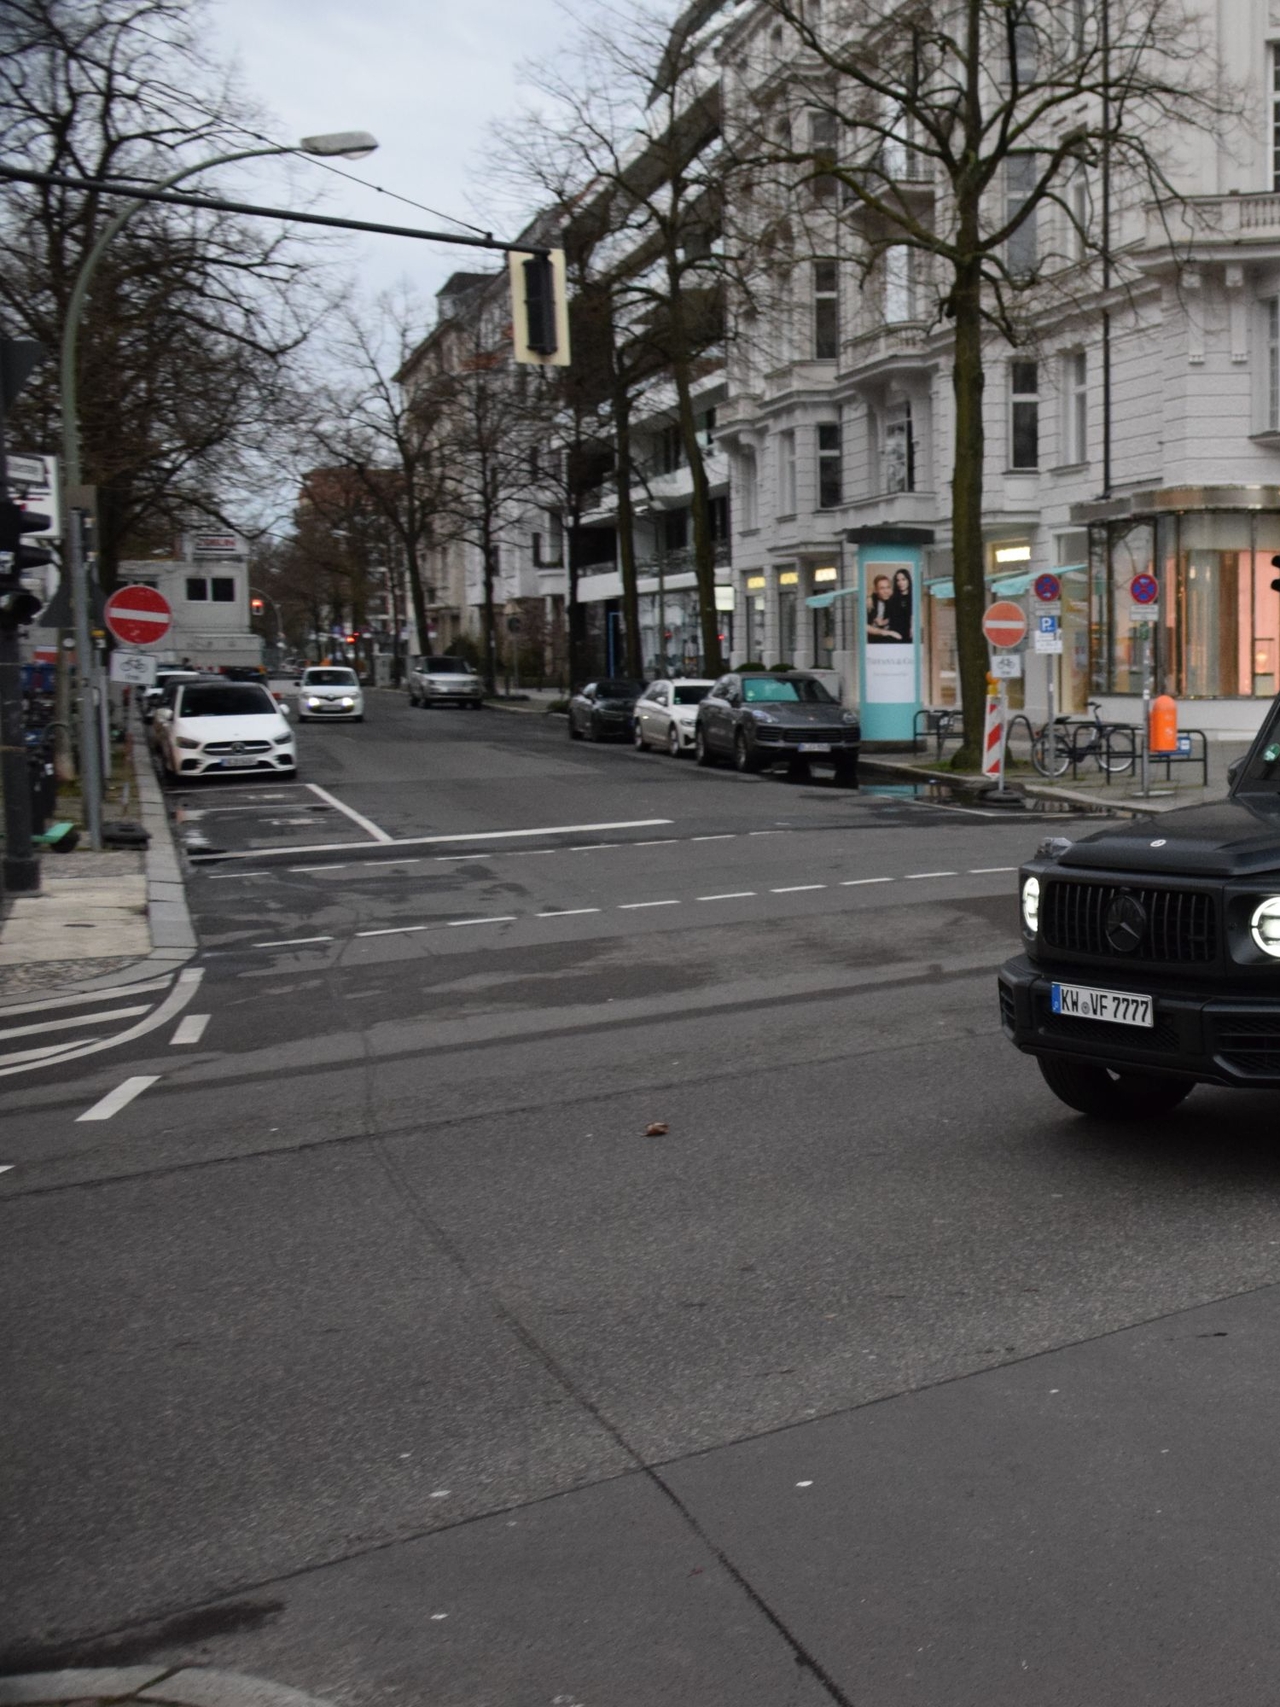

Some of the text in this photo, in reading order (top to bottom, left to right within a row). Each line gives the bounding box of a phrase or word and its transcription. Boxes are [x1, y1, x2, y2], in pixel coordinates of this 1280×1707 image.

[1061, 988, 1149, 1023] KW VF 7777
